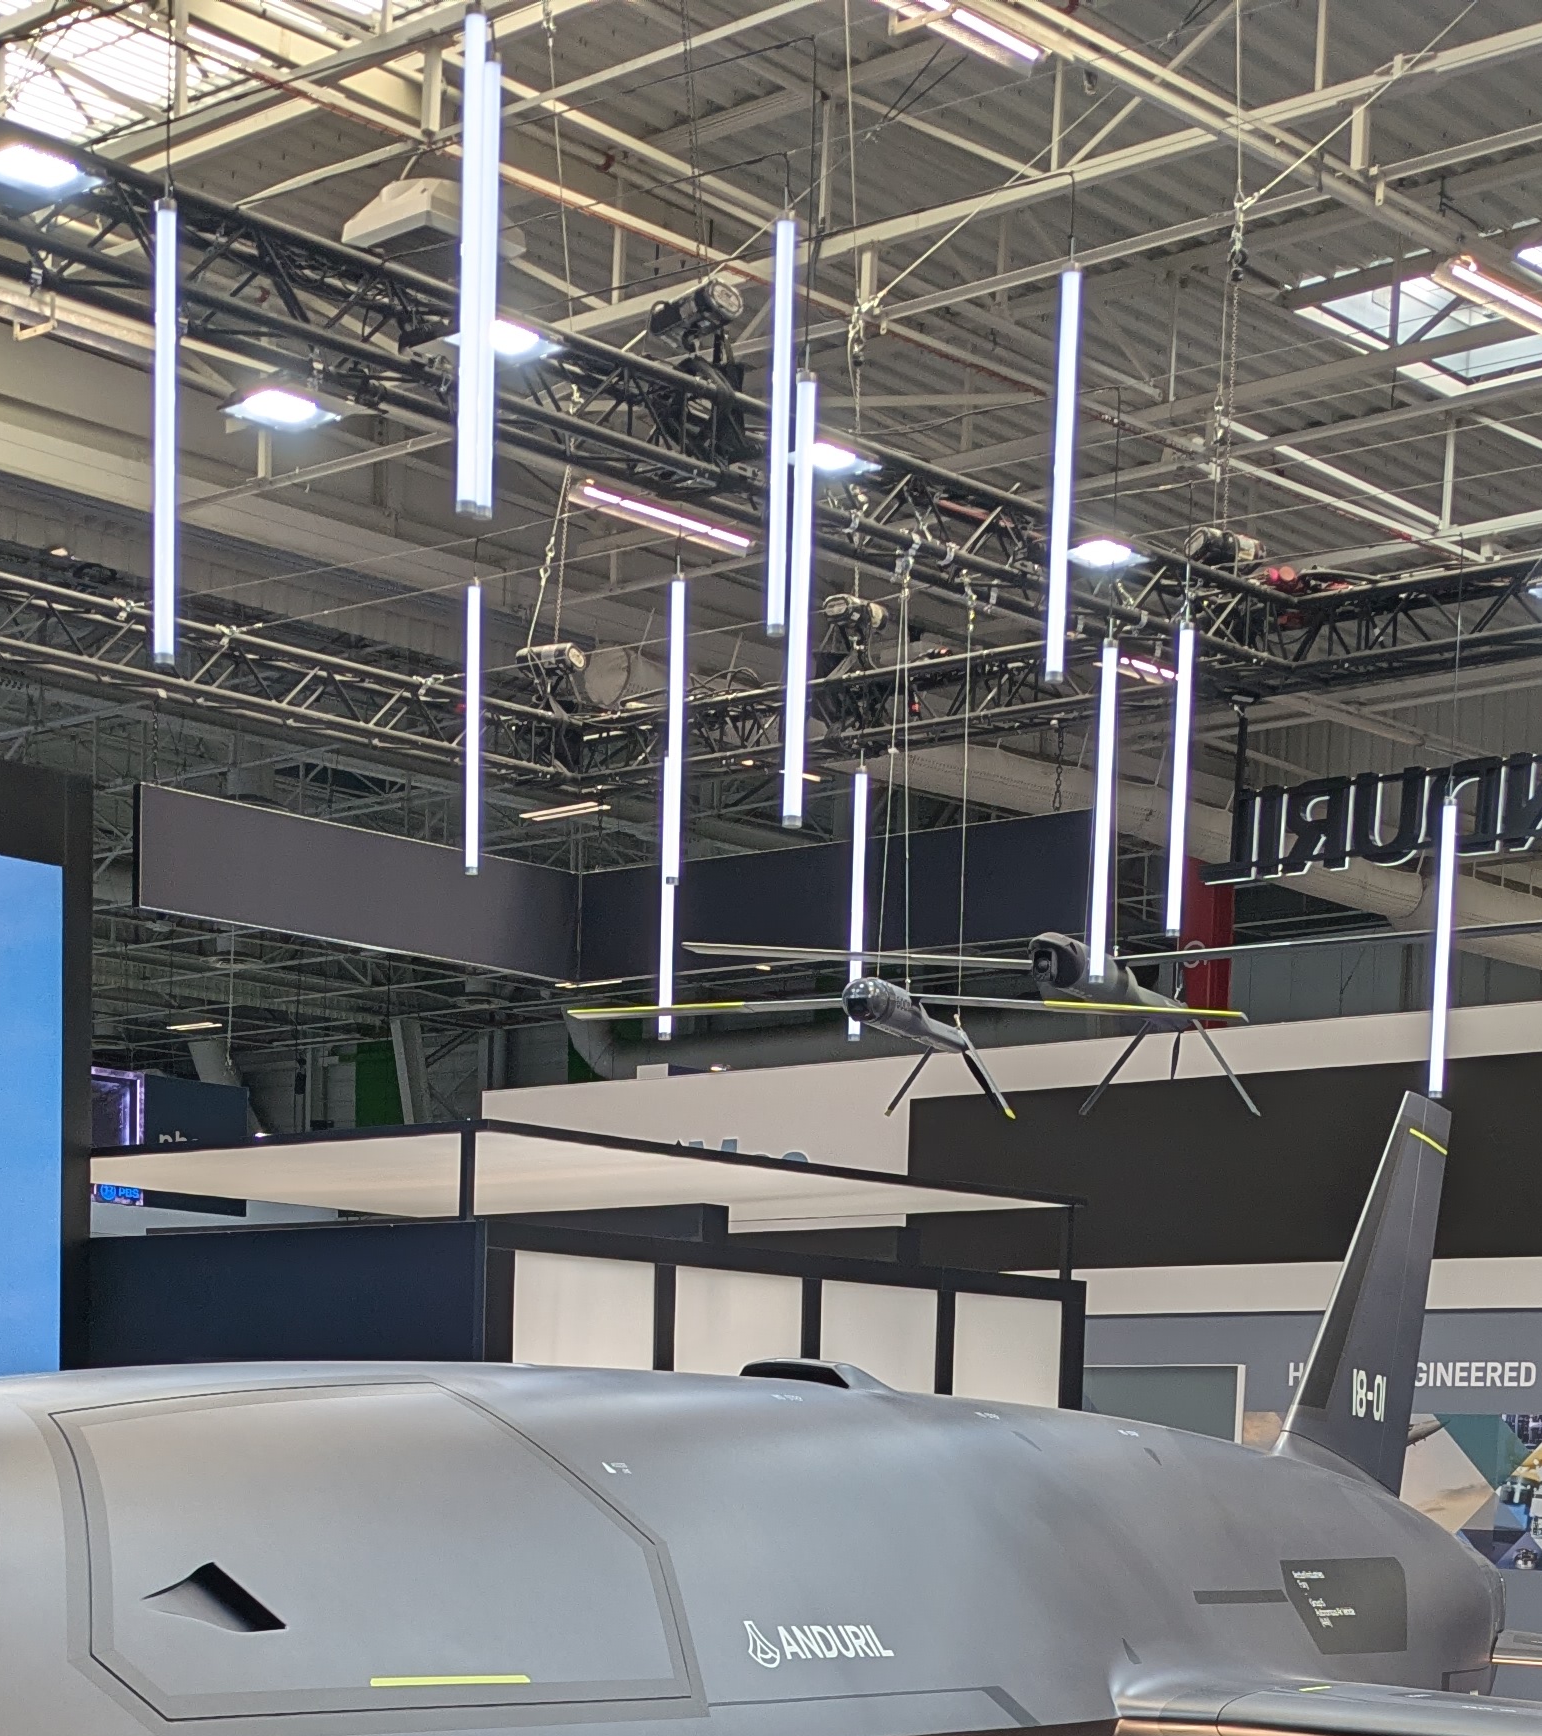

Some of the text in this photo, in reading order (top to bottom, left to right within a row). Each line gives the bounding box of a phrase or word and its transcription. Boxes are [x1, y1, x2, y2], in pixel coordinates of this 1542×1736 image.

[1414, 1361, 1536, 1388] GINEERED
[1352, 1368, 1386, 1422] 18-01
[777, 1625, 895, 1660] ANDURIL
